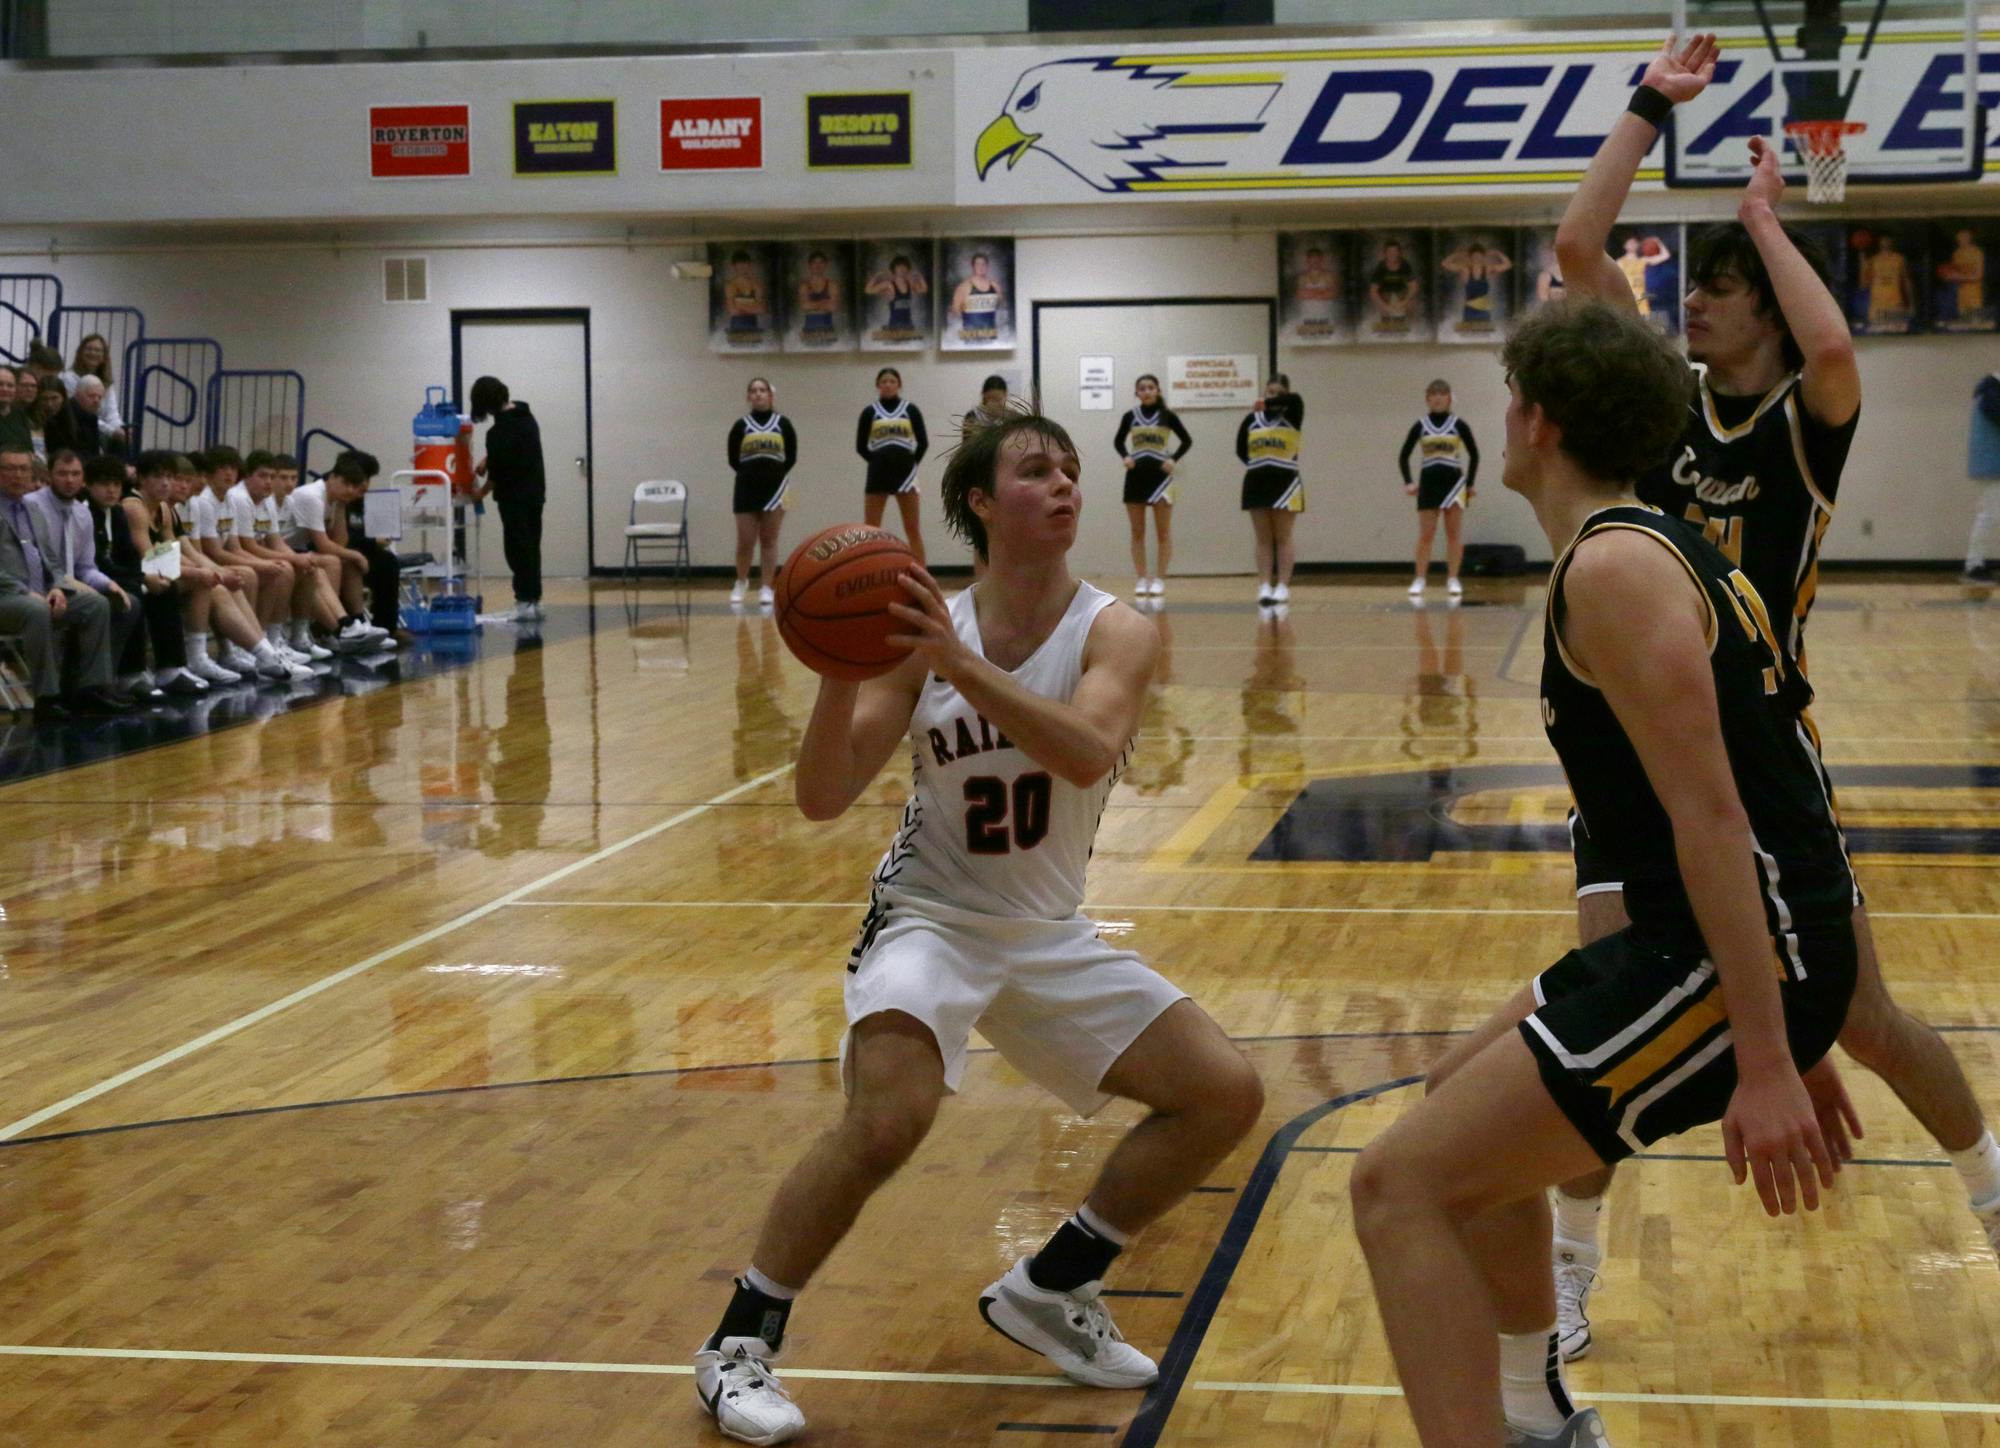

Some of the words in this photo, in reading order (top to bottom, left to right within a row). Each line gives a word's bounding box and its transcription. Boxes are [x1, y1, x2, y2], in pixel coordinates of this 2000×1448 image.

[374, 126, 465, 143] ROYERTON
[527, 121, 599, 142] EATON
[669, 117, 753, 138] ALBANY
[962, 770, 1053, 856] 20
